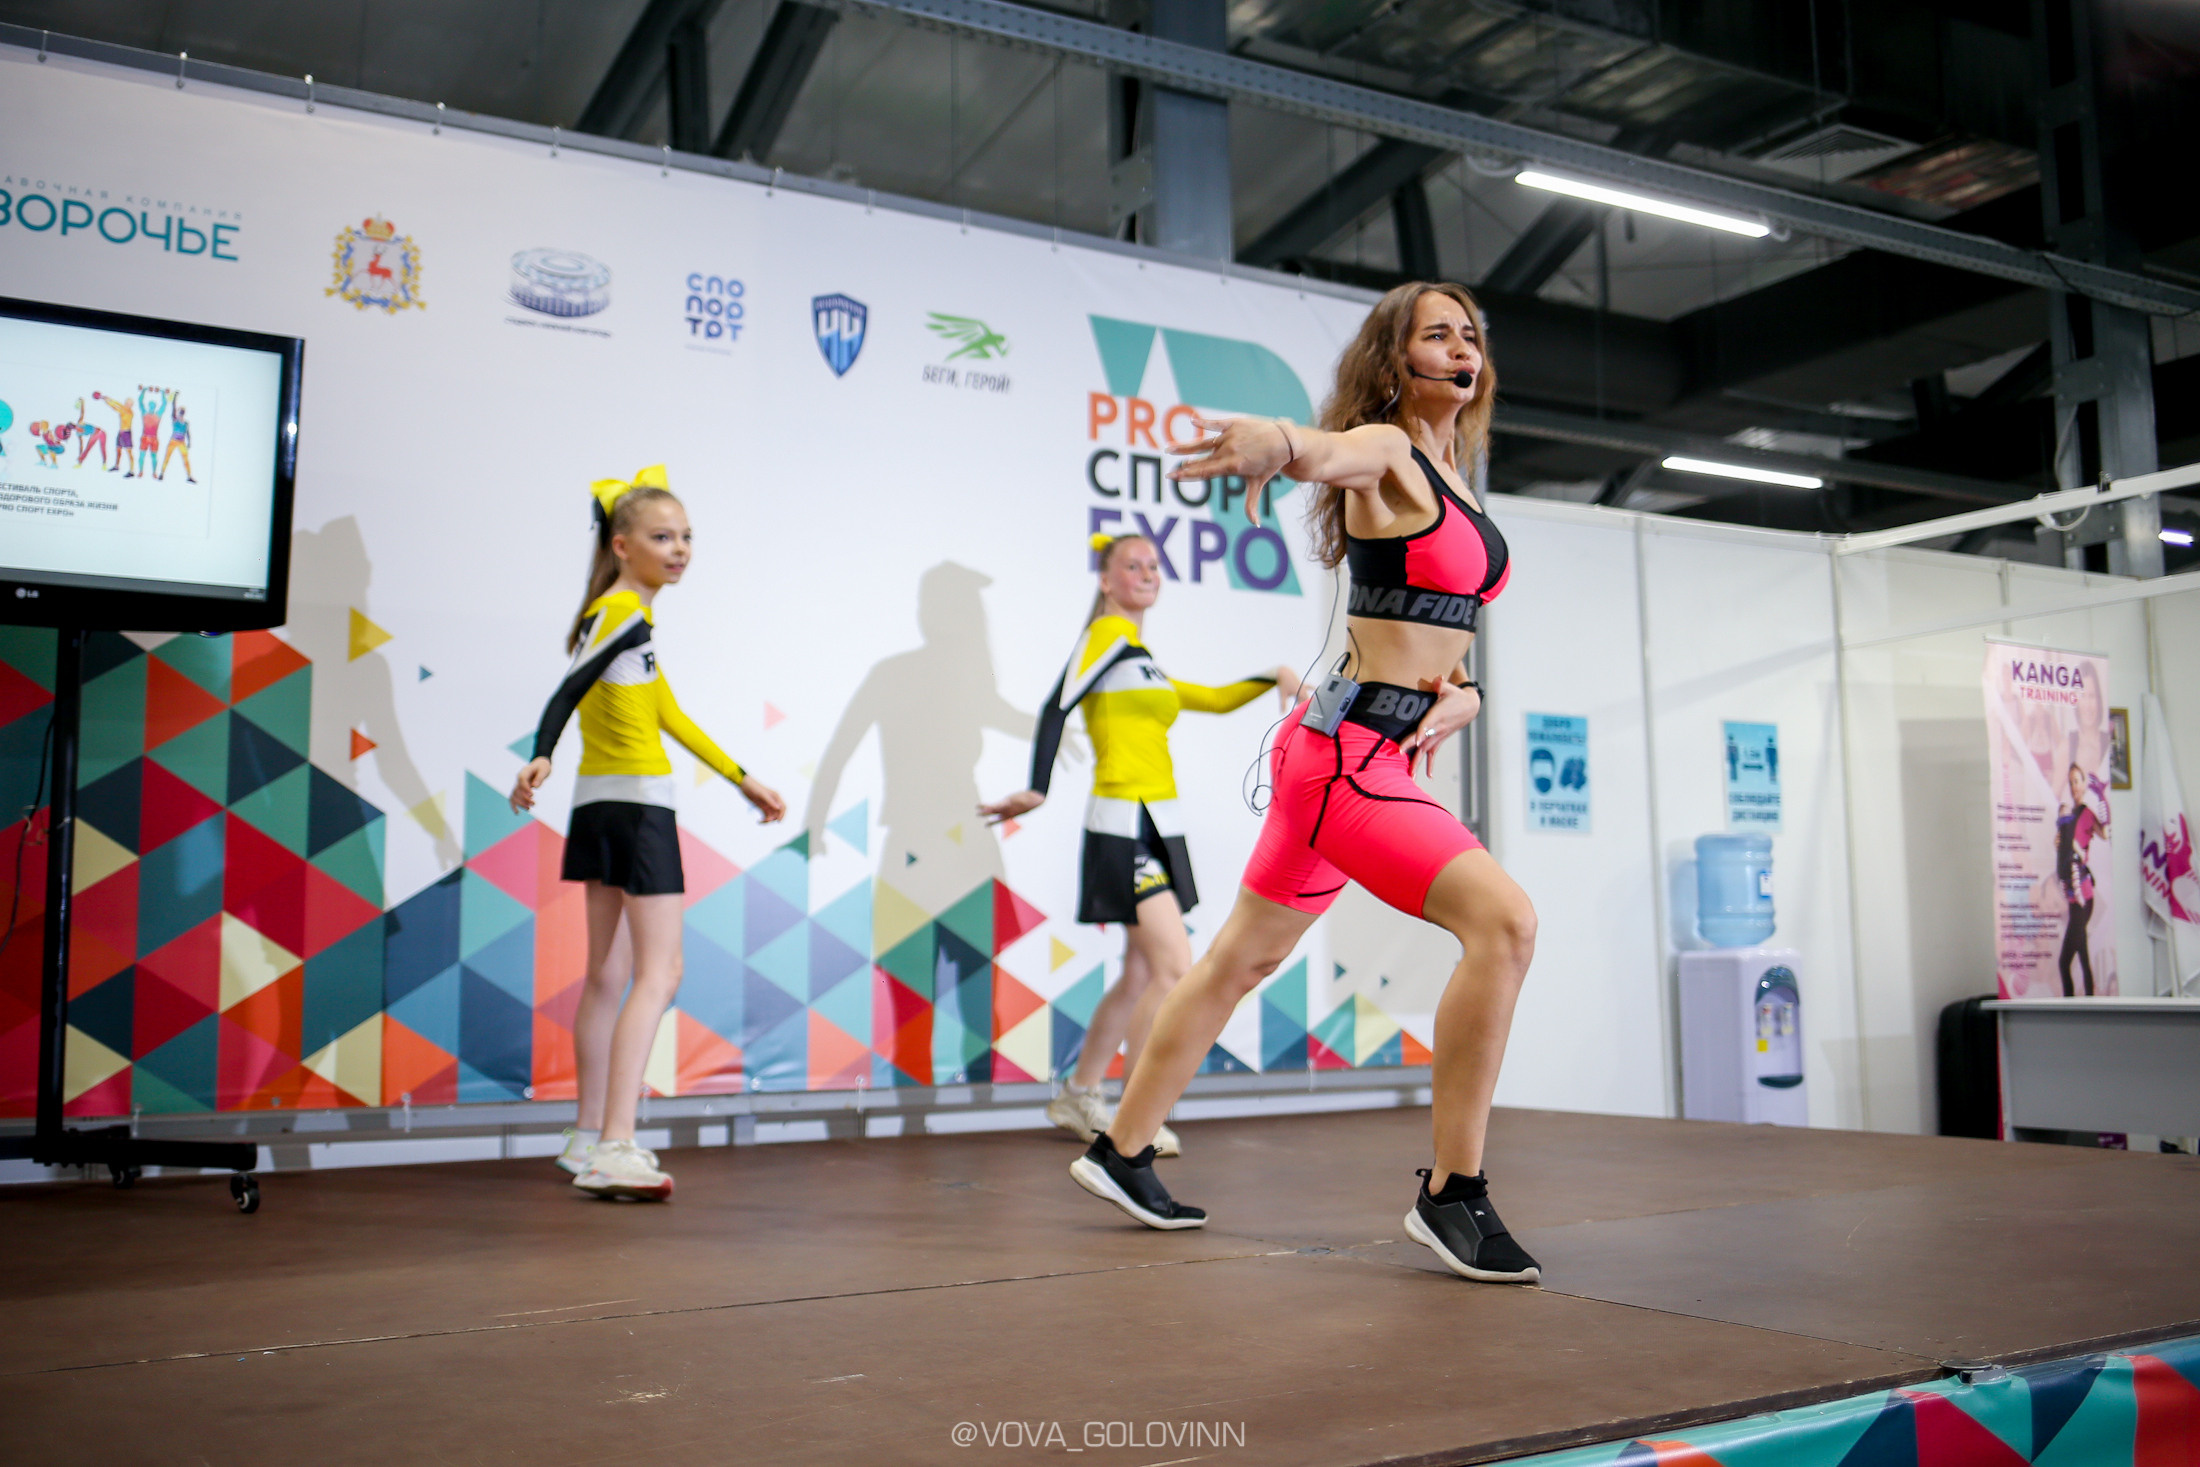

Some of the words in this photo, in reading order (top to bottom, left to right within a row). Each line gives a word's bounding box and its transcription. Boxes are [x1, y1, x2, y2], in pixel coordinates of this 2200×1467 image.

[1087, 391, 1205, 450] PRO
[2011, 660, 2085, 689] KANGA
[2019, 685, 2079, 706] TRAINING
